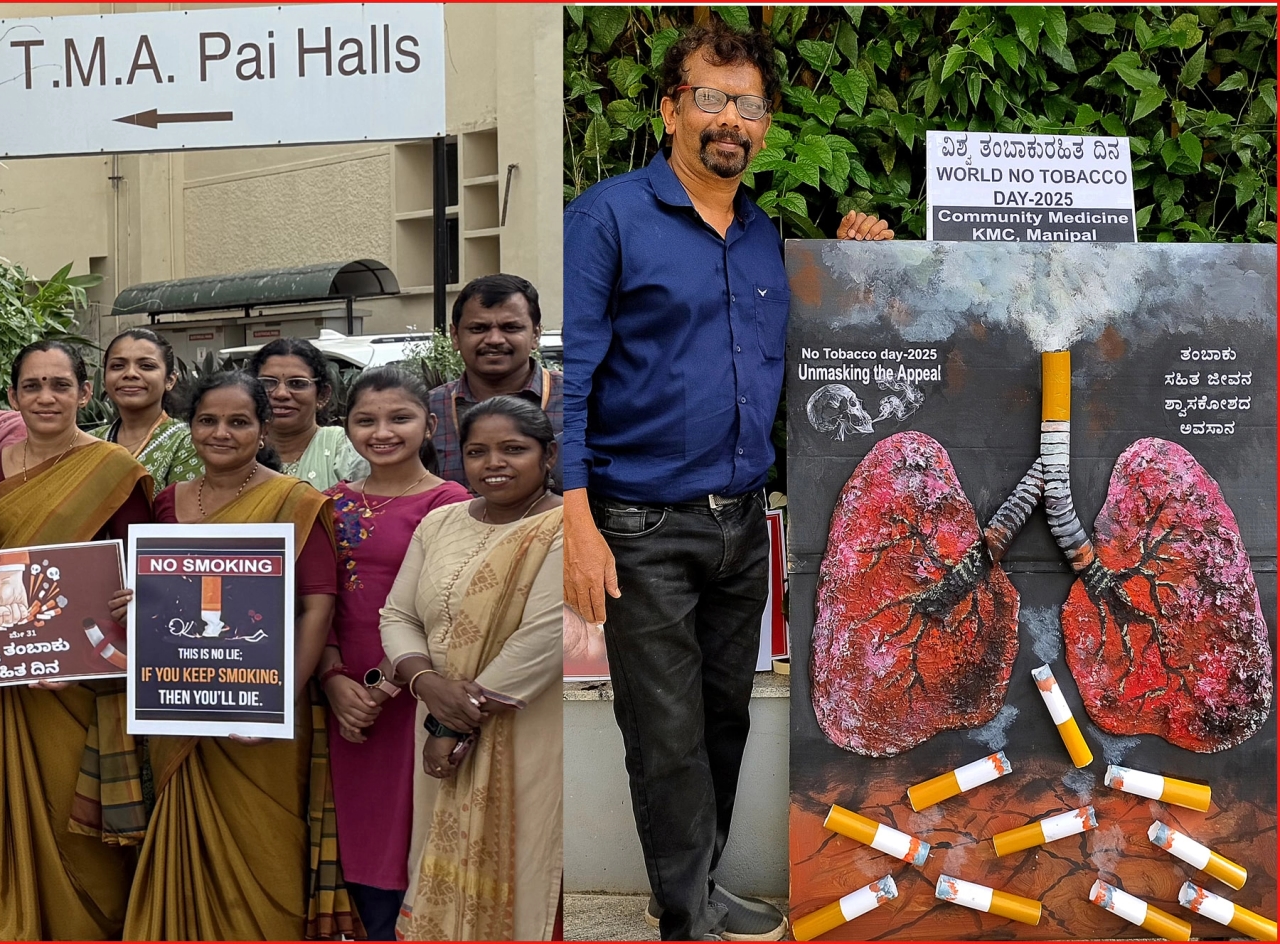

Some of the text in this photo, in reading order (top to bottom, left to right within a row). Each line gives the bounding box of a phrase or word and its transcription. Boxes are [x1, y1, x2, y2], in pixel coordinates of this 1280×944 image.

[10, 23, 421, 90] T.M.A. Pai Halls
[941, 134, 1119, 165] ವಿಶ್ವ ತಂಬಾಕುರಹಿತ ದಿನ
[936, 167, 1127, 184] WORLD NO TOBACCO
[993, 191, 1074, 206] DAY-2025
[937, 210, 1129, 226] Community Medicine
[972, 228, 1097, 242] KMC, Manipal
[802, 348, 937, 362] No Tobacco day-2025
[1180, 346, 1236, 360] ತಂಬಾಕು
[798, 363, 941, 384] Unmasking the Appeal
[1164, 371, 1252, 385] ಸಹಿತ ಜೀವನ
[1164, 395, 1251, 417] ಶ್ವಾಸಕೋಶದ
[1180, 421, 1235, 434] ಅವಸಾನ
[150, 559, 273, 573] NO SMOKING
[3, 637, 70, 656] ತಂಬಾಕು
[178, 648, 243, 661] THIS IS NO LIE;
[30, 659, 60, 675] ದಿನ
[141, 667, 282, 686] IF YOU KEEP SMOKING,
[158, 689, 263, 706] THEN YOU'LL DIE.
